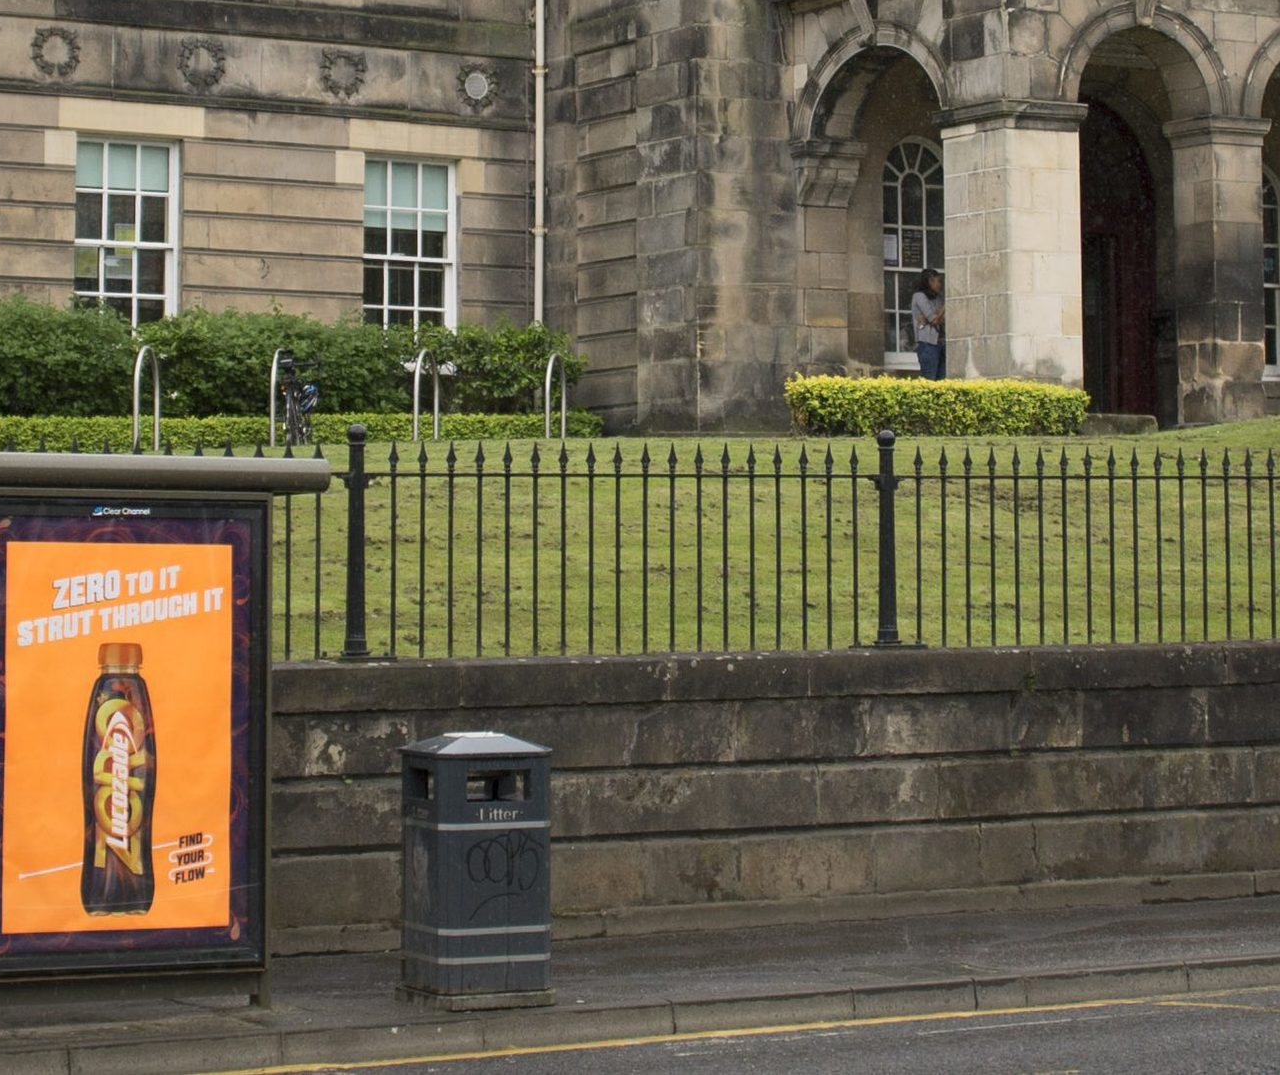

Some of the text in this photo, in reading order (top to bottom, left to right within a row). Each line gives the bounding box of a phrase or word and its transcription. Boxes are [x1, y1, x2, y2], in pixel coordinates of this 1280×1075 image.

[103, 507, 151, 515] Clear Channel
[52, 565, 181, 610] ZERO TO IT
[17, 587, 224, 647] STRUT THROUGH IT
[105, 732, 129, 850] Lucozade
[479, 807, 519, 821] Litter
[179, 832, 203, 848] FIND
[176, 850, 204, 866] YOUR
[175, 866, 205, 884] FLOW
